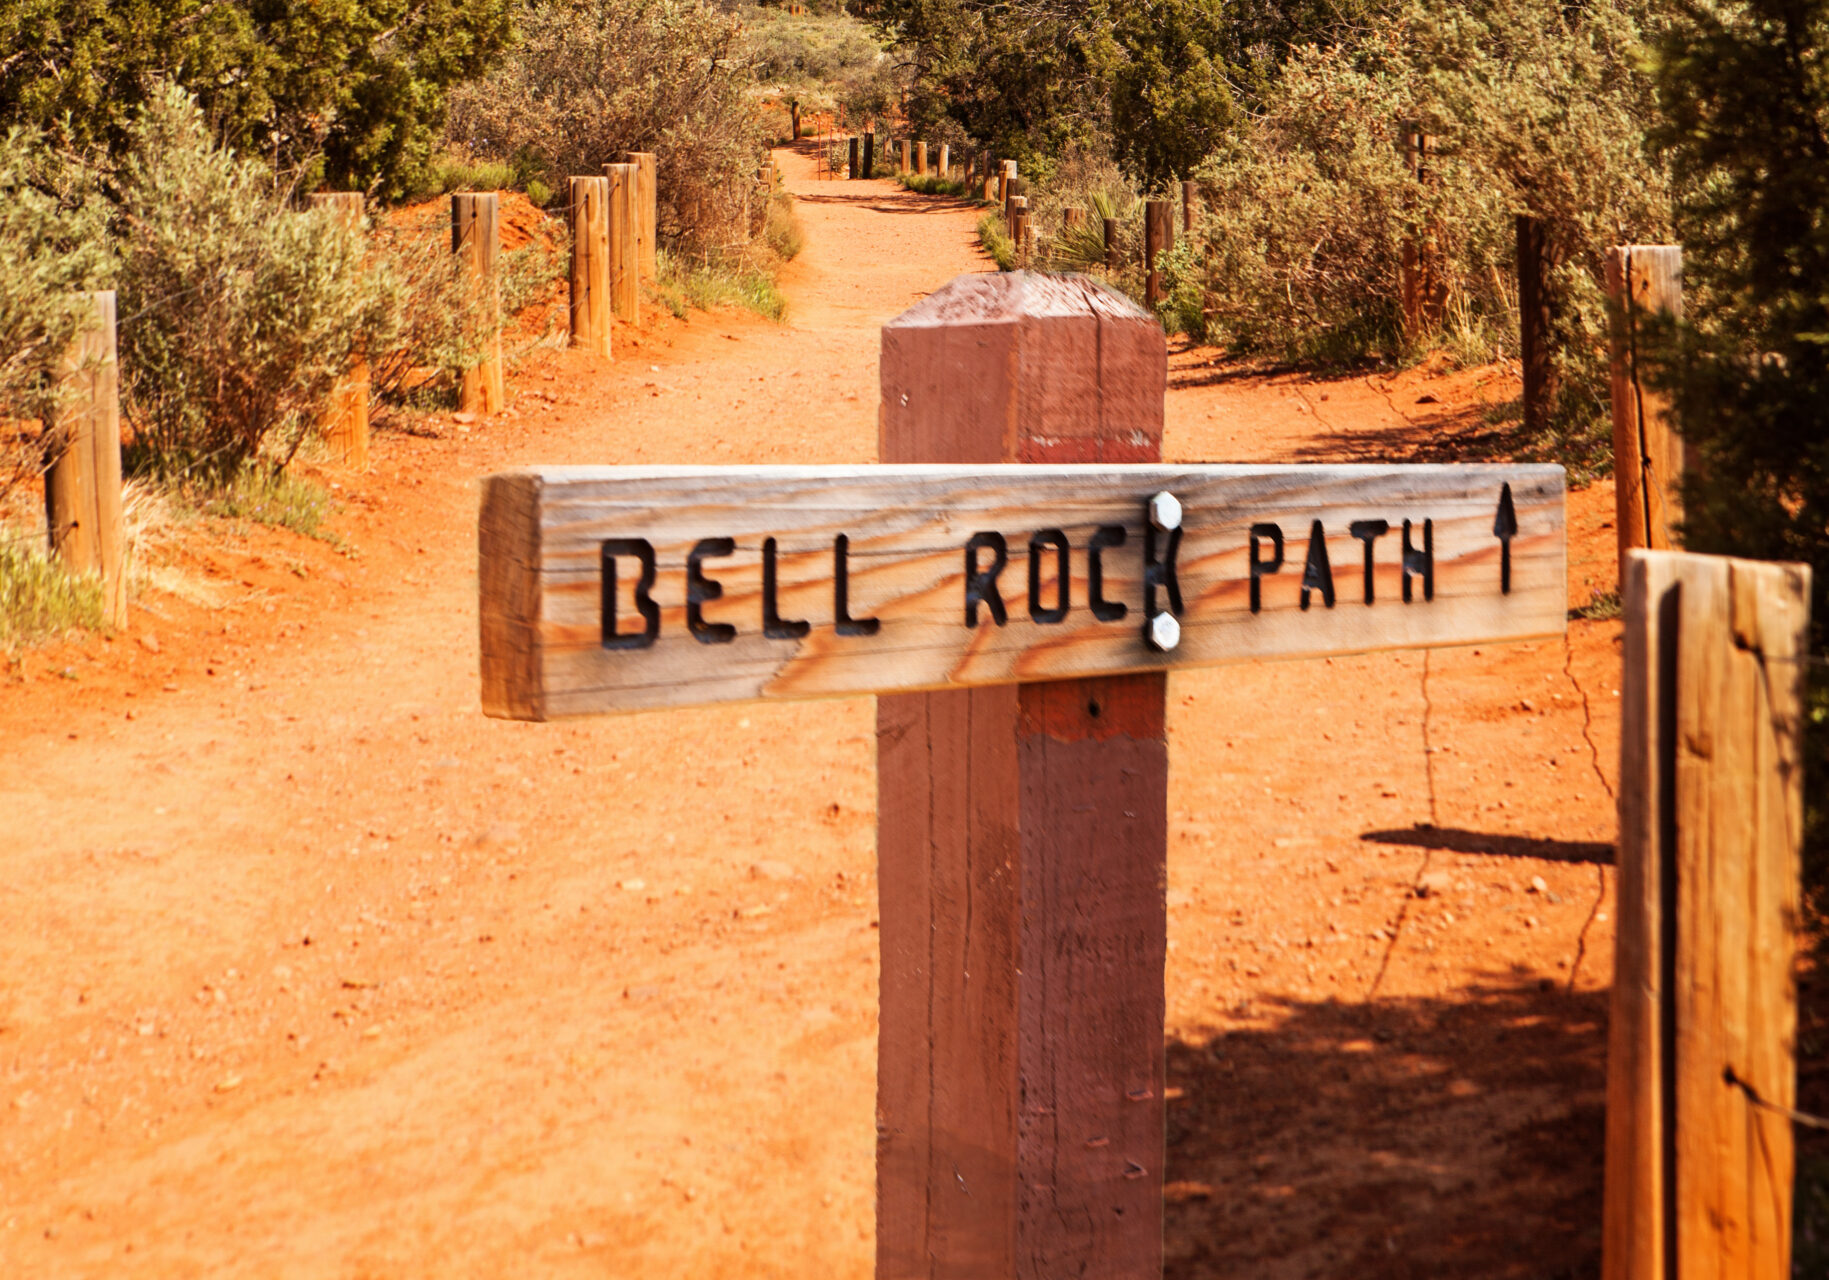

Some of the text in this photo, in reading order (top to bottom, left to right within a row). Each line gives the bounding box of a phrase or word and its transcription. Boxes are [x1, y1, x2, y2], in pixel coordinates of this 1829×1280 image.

[602, 517, 1435, 650] BELL ROCK PATH
